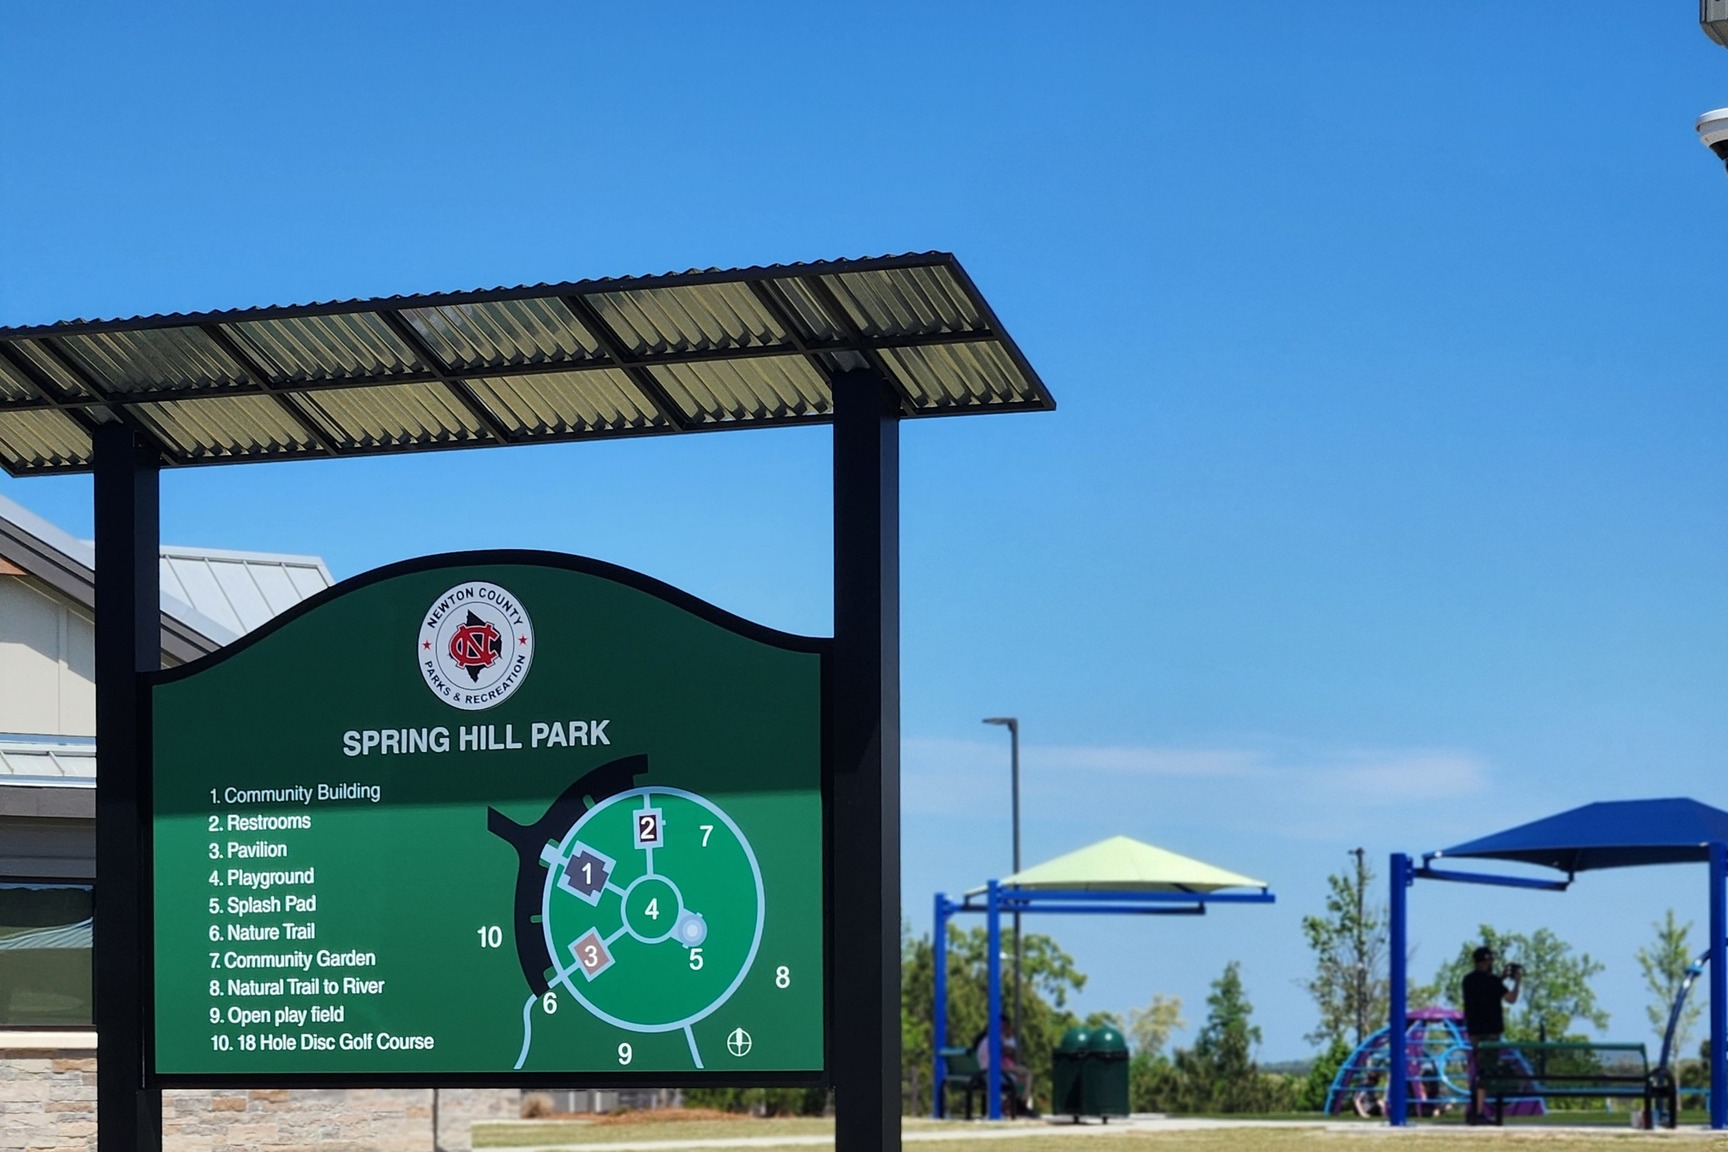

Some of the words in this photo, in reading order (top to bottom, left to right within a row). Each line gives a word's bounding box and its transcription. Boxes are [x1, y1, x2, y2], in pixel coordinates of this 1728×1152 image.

[427, 587, 474, 629] NEWTON
[478, 587, 523, 626] COUNTY
[424, 660, 452, 697] PARKS
[453, 692, 461, 702] &
[465, 655, 526, 705] RECREATION
[343, 725, 450, 757] SPRING
[459, 724, 523, 751] HILL
[531, 719, 611, 748] PARK
[210, 788, 221, 804] 1.
[224, 785, 313, 805] Community
[317, 783, 381, 803] Building
[208, 815, 224, 832] 2.
[227, 814, 312, 831] Restrooms
[640, 817, 655, 840] 2
[699, 825, 714, 848] 7
[208, 843, 224, 860] 3.
[227, 840, 288, 859] Pavilion
[208, 870, 224, 887] 4.
[227, 867, 315, 890] Playground
[581, 862, 592, 885] 1
[208, 897, 224, 915] 5.
[227, 895, 281, 917] Splash
[285, 894, 317, 912] Pad
[644, 898, 660, 920] 4
[208, 924, 224, 942] 6.
[227, 924, 280, 941] Nature
[282, 922, 315, 940] Trail
[476, 925, 503, 949] 10
[208, 952, 221, 969] 7.
[223, 950, 313, 972] Community
[316, 949, 376, 967] Garden
[583, 945, 598, 968] 3
[688, 947, 704, 971] 5
[209, 979, 224, 997] 8.
[227, 978, 284, 996] Natural
[286, 977, 320, 995] Trail
[322, 978, 340, 995] to
[343, 977, 386, 994] River
[775, 965, 791, 989] 8
[542, 991, 558, 1015] 6
[209, 1007, 225, 1024] 9.
[227, 1006, 271, 1028] Open
[274, 1005, 308, 1027] play
[310, 1005, 345, 1023] field
[210, 1034, 234, 1051] 10.
[237, 1034, 257, 1051] 18
[260, 1033, 297, 1051] Hole
[300, 1033, 336, 1051] Disc
[339, 1032, 374, 1051] Golf
[376, 1032, 435, 1050] Course
[617, 1042, 633, 1065] 9
